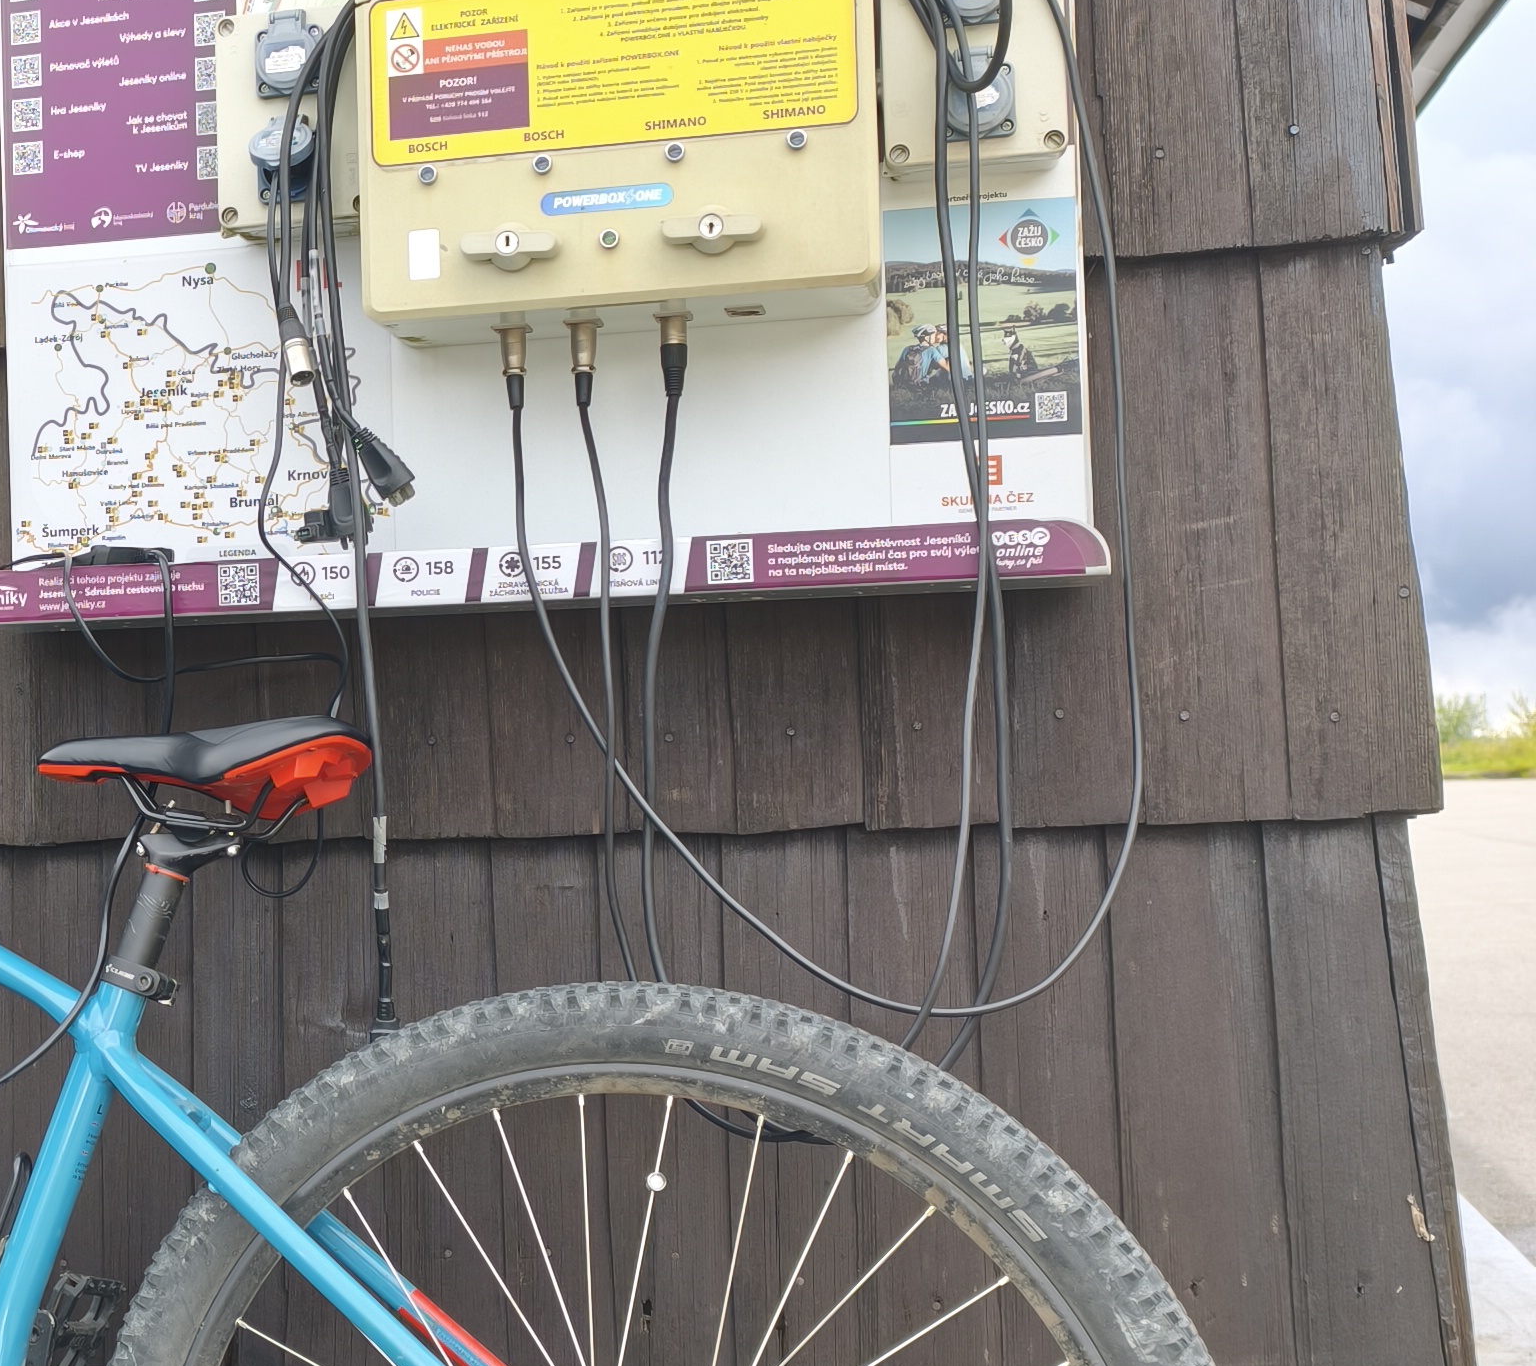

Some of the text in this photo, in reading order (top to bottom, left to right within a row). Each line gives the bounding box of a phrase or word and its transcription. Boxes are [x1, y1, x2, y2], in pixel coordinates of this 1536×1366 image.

[48, 18, 71, 29] Akce
[79, 11, 130, 26] Jeseníkách
[460, 8, 488, 18] POZOR
[431, 14, 519, 32] ELEKTRICKÉ ZAŘÍZENÍ
[119, 29, 153, 45] Výhody
[162, 27, 187, 39] slevy
[445, 39, 506, 53] NEHAS VODOU
[49, 59, 91, 73] Plánovač
[424, 57, 440, 66] ANI
[119, 71, 187, 88] Jeseníky online
[439, 76, 477, 89] POZOR!
[50, 101, 107, 116] Hra Jeseníky
[762, 104, 826, 120] SHIMANO
[126, 110, 188, 126] Jak se chovat
[644, 115, 707, 132] SHIMANO
[140, 120, 188, 134] Jeseníkům
[523, 129, 565, 142] BOSCH
[53, 148, 86, 160] E-shop
[408, 141, 448, 153] BOSCH
[135, 160, 189, 174] TV Jeseníky
[553, 188, 663, 209] POWERBOX ONE
[979, 191, 1008, 201] rojektu
[1017, 224, 1042, 237] ZAŽIJ
[1015, 236, 1044, 248] ČESKO
[182, 274, 214, 289] Nysa
[140, 385, 188, 399] Jeseník
[287, 469, 328, 481] Krnov
[1006, 491, 1034, 504] ČEZ
[41, 524, 100, 539] Šumperk
[993, 532, 1030, 544] YES
[768, 533, 972, 554] Sledujte ONLINE návštěvnost Jeseníků
[996, 544, 1044, 557] online
[219, 548, 257, 558] LEGENDA
[611, 552, 627, 566] SOS
[778, 554, 836, 566] naplánujte
[837, 553, 847, 562] si
[848, 550, 885, 562] ideální
[887, 548, 908, 560] čas
[909, 549, 928, 561] pro
[930, 545, 952, 558] svůj
[954, 543, 979, 557] výlet
[425, 560, 454, 575] 158
[532, 555, 562, 571] 155
[768, 561, 909, 577] na ta nejoblíbenější místa.
[38, 572, 144, 587] Realizci tohoto projektu
[321, 565, 350, 580] 150
[84, 582, 205, 597] Sdružení ruchu
[610, 578, 644, 588] TÍSŇOVÁ
[411, 588, 441, 597] POLICIE
[710, 1042, 1050, 1244] SMART SAM
